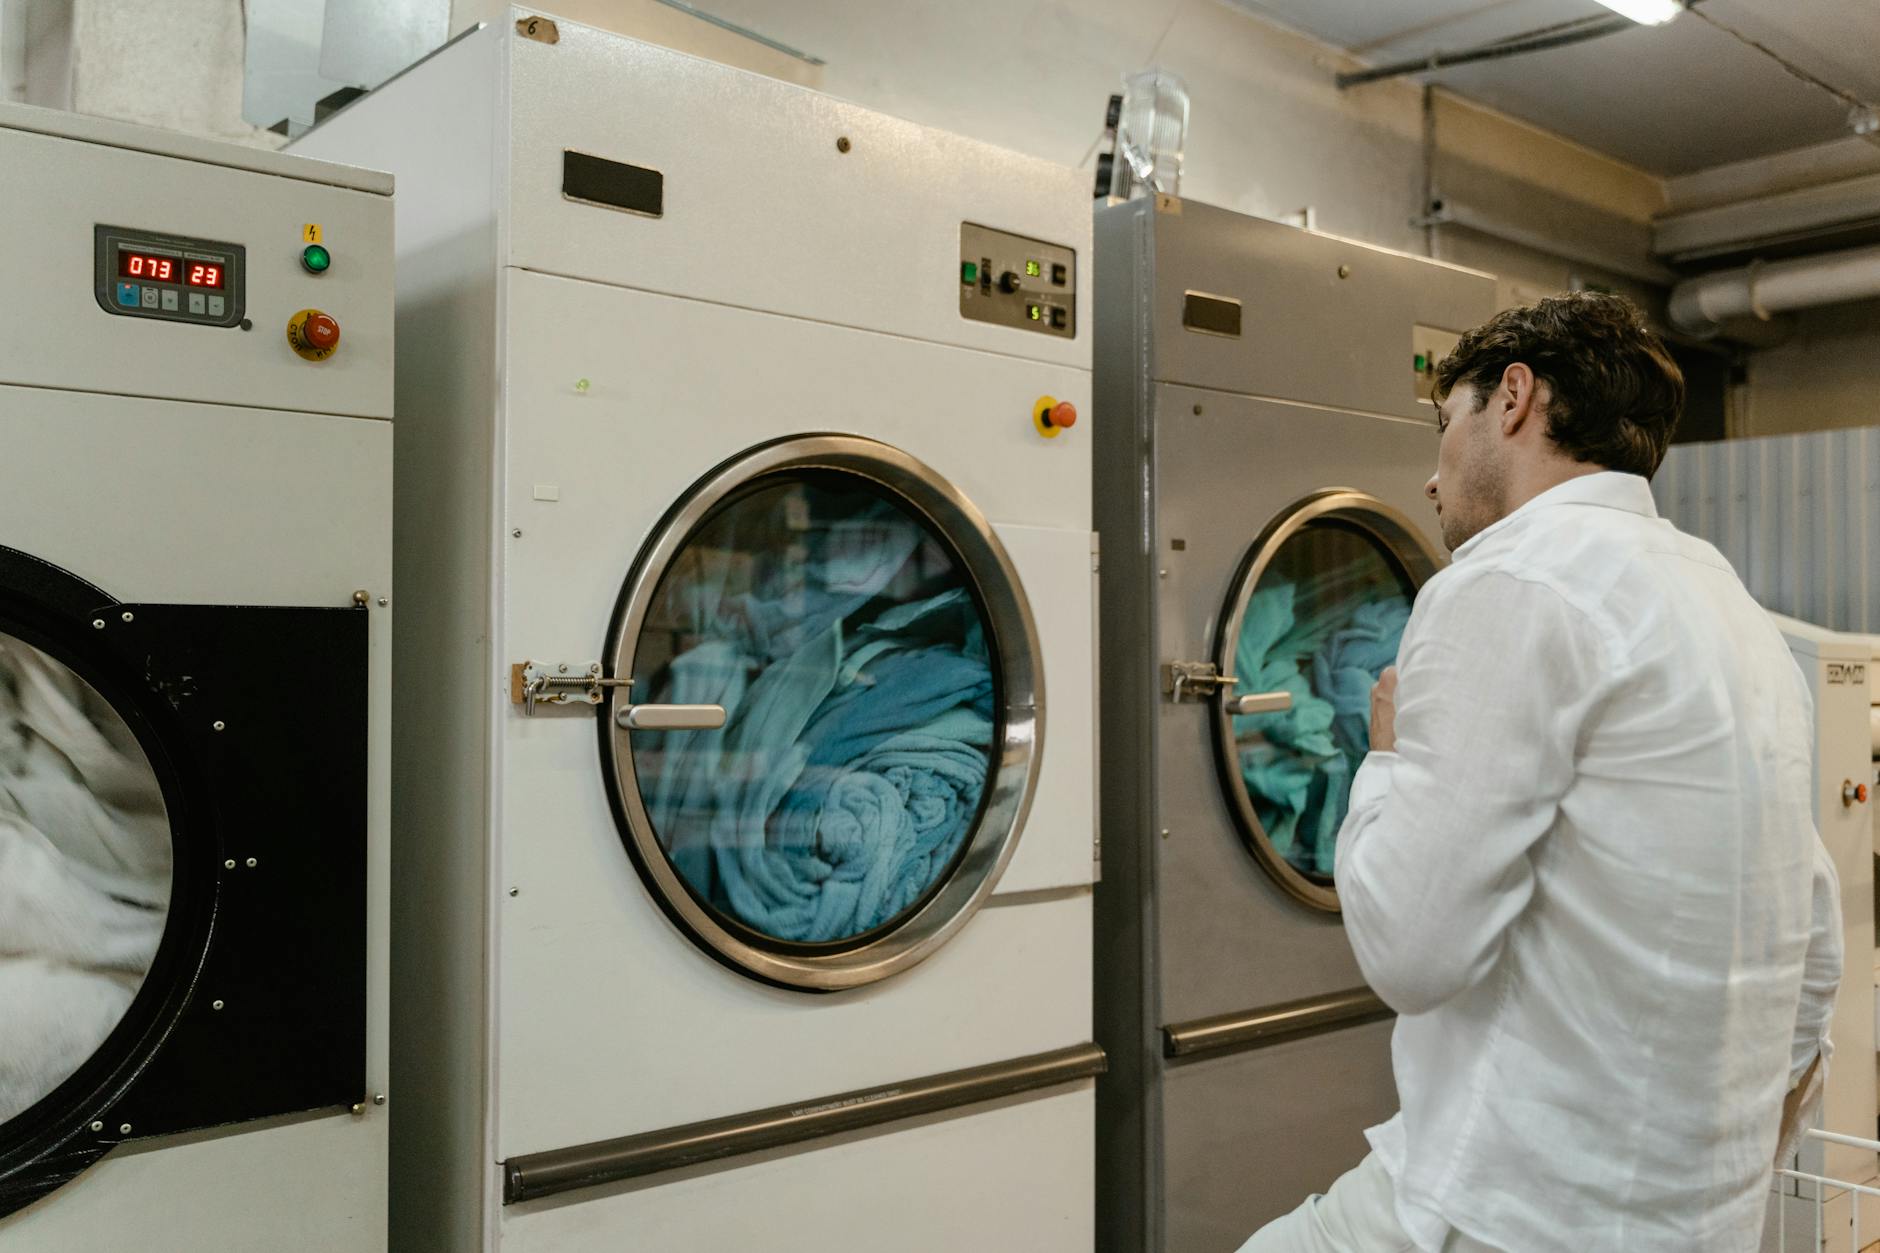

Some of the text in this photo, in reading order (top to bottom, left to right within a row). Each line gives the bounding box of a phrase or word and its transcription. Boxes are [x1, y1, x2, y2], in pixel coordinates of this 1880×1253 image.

[528, 20, 538, 35] 6
[129, 256, 171, 279] 073
[191, 265, 217, 285] 23
[317, 325, 332, 336] STOP
